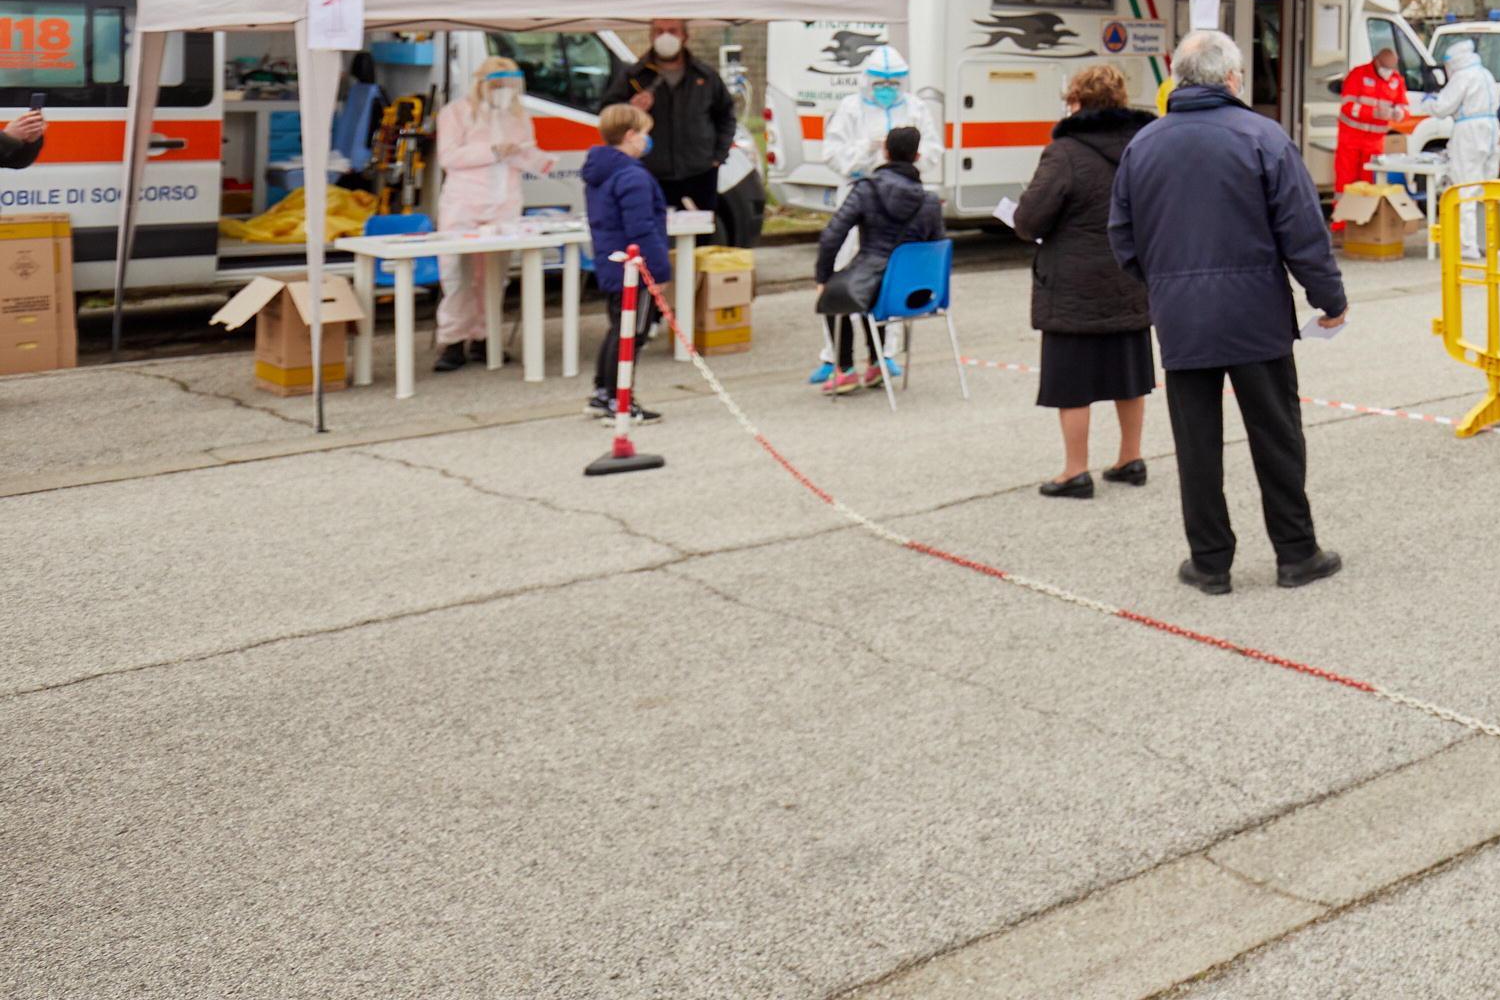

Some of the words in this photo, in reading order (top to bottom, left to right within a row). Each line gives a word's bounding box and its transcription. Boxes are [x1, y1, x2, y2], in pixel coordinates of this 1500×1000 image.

[0, 18, 72, 51] 118
[0, 189, 61, 207] OBILE
[67, 188, 85, 204] DI
[91, 184, 197, 203] SOORSO
